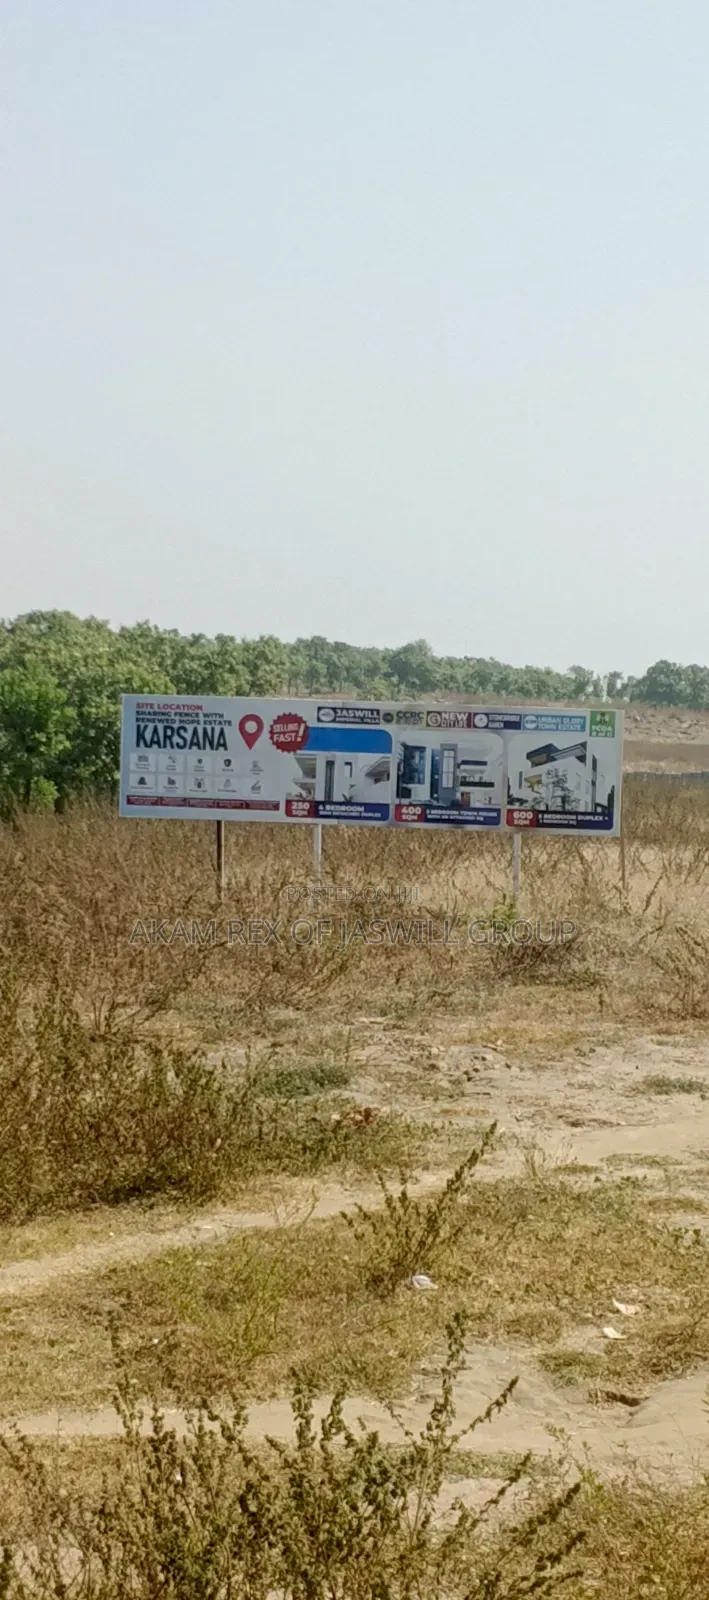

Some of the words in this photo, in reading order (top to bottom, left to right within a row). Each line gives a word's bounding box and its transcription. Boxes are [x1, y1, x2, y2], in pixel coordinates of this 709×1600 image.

[336, 709, 380, 717] JASWILL
[273, 723, 298, 732] SELLING
[136, 724, 228, 751] KARSANA
